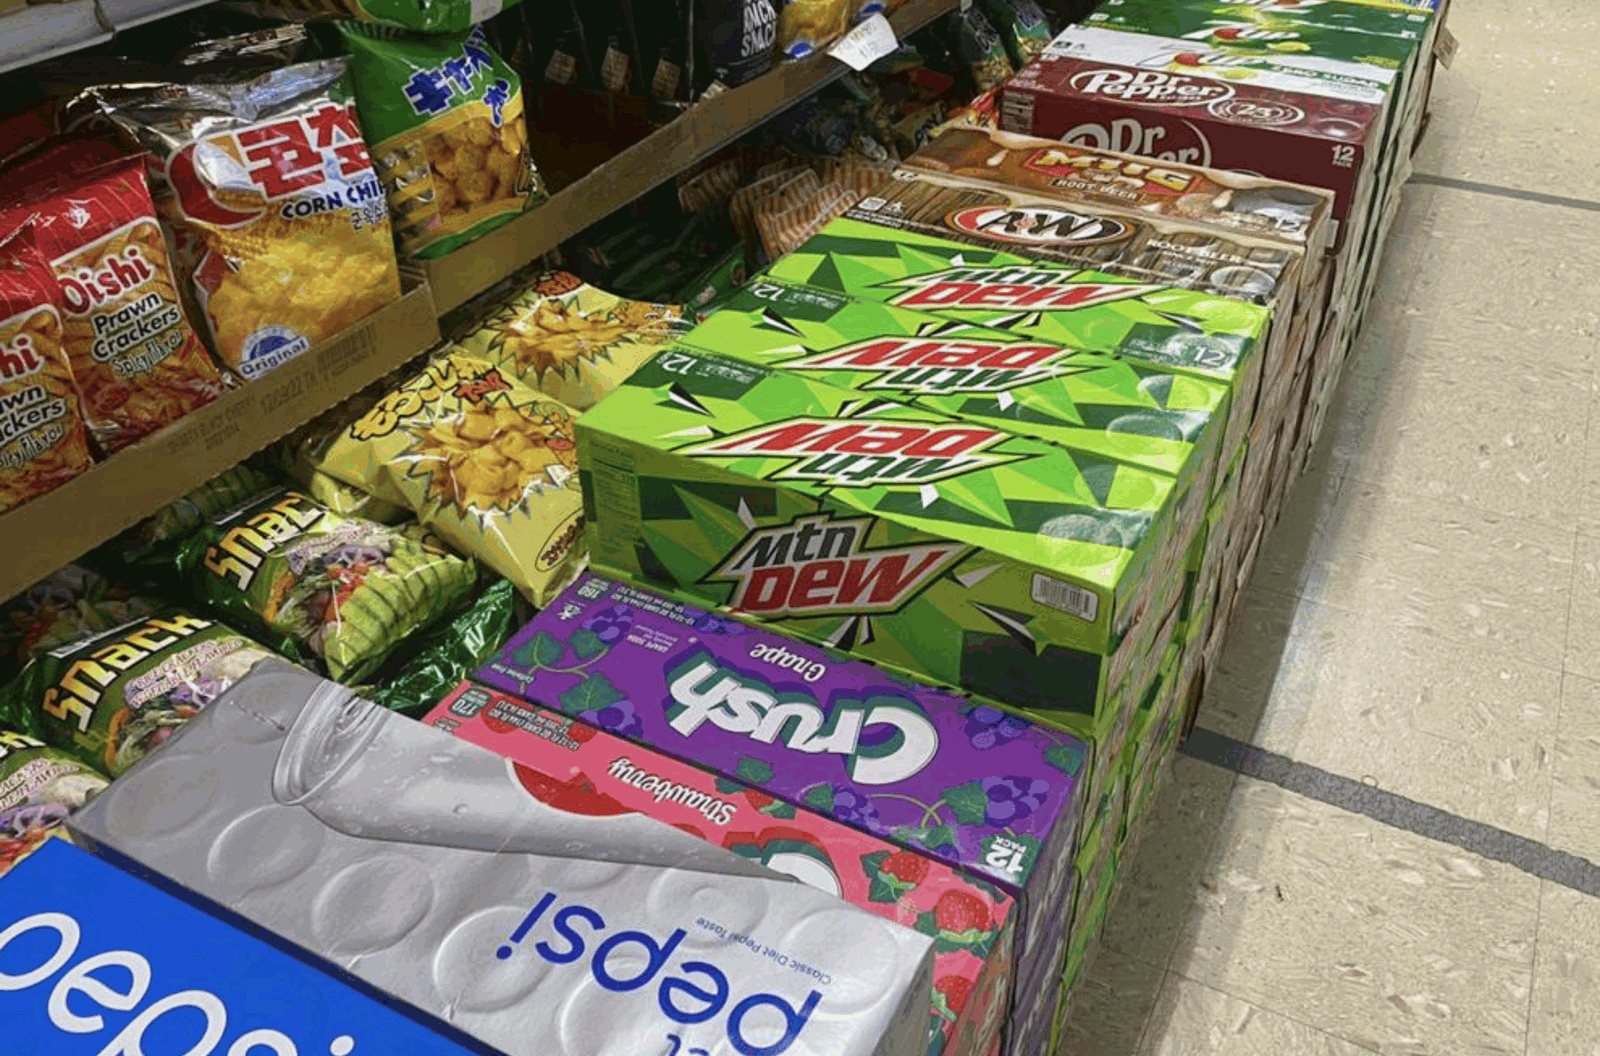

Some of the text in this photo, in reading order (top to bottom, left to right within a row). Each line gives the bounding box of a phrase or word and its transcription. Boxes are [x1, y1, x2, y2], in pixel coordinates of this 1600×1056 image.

[1080, 70, 1224, 99] Pepper
[1132, 71, 1192, 86] Dr
[1332, 144, 1355, 162] 12
[282, 192, 343, 218] CORN
[58, 248, 152, 314] Oishi
[914, 267, 1060, 285] Mtn
[754, 283, 785, 300] 12
[94, 293, 160, 334] Prawn
[94, 306, 179, 358] Crackers
[112, 346, 151, 376] Spicy
[242, 341, 306, 375] Original
[663, 353, 698, 375] 12
[1194, 346, 1226, 367] 12
[888, 366, 1056, 391] Mtn
[802, 453, 976, 482] Mtn
[736, 519, 855, 572] Mtn
[730, 549, 950, 613] Dew
[750, 642, 826, 683] Grape
[450, 698, 475, 717] 170
[669, 661, 938, 784] Crush
[607, 756, 737, 827] Strawberry
[986, 843, 1024, 874] 12
[695, 917, 831, 985] Classic Diet Pepsi Taste
[495, 891, 824, 1056] pepsi
